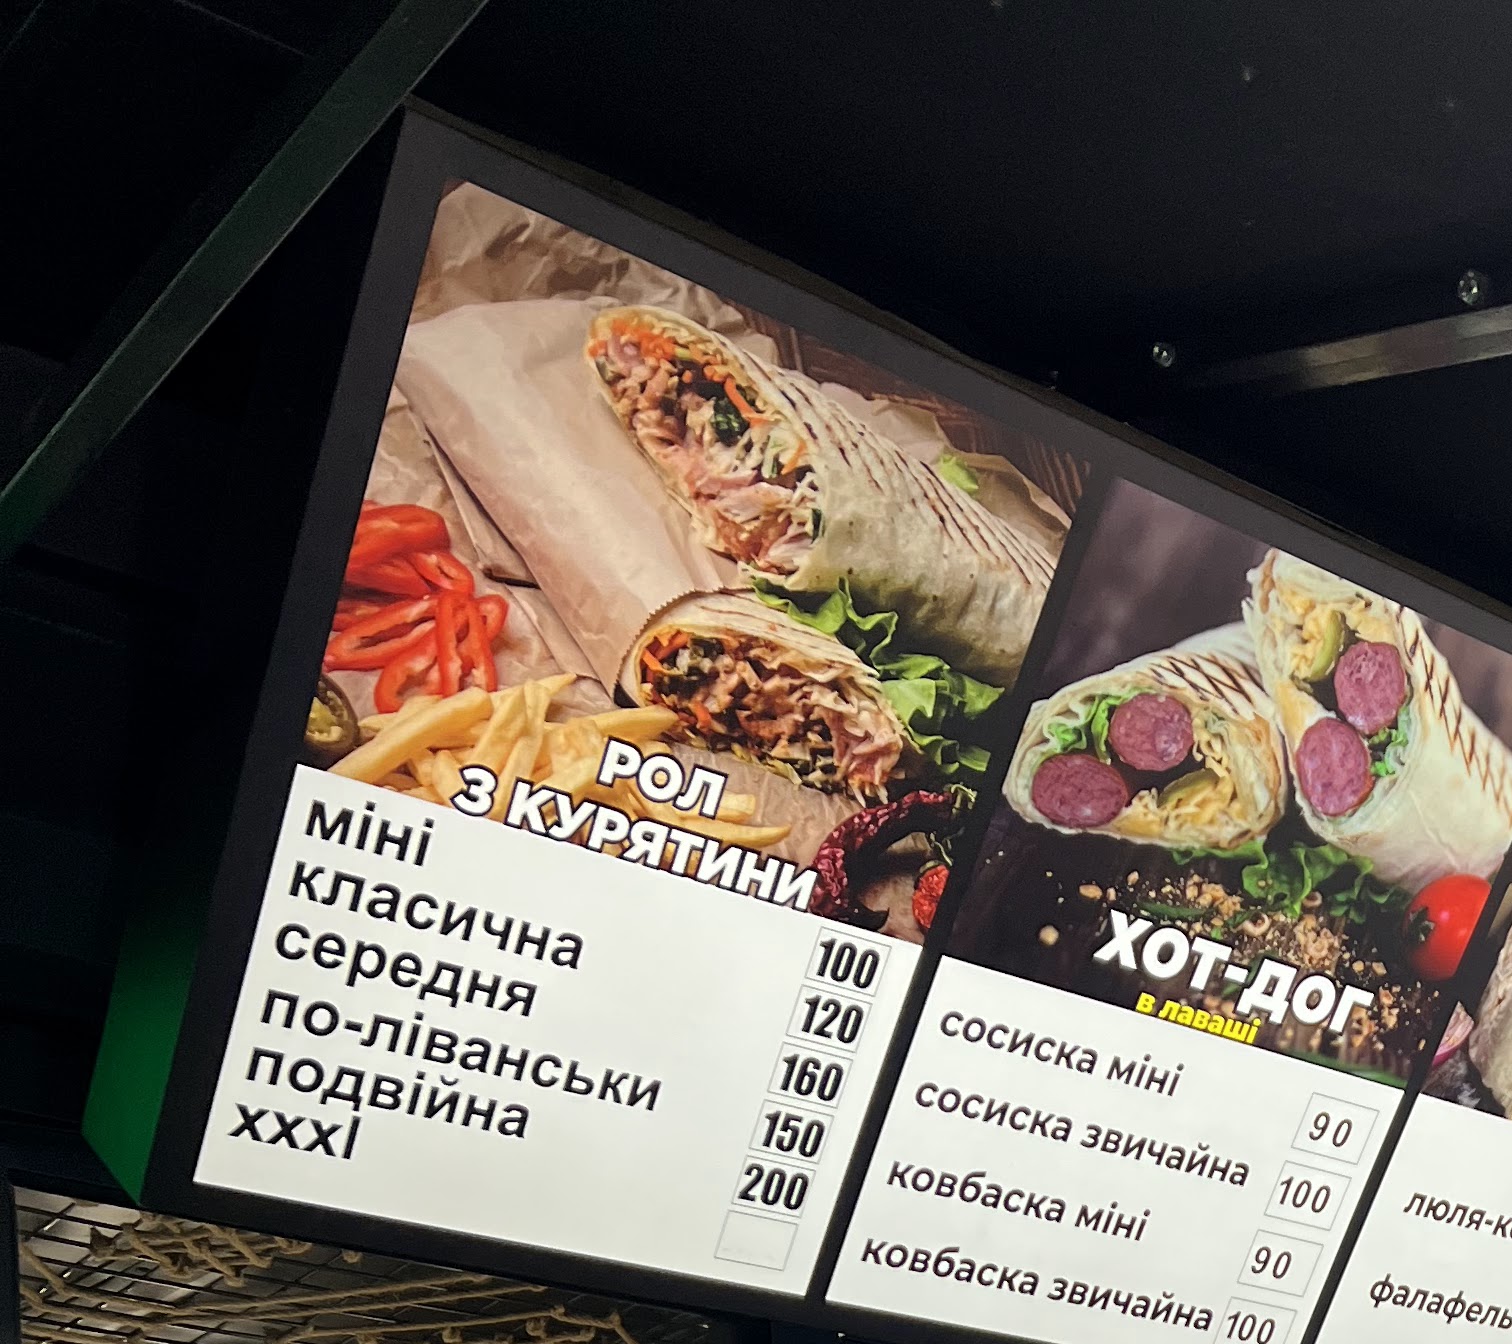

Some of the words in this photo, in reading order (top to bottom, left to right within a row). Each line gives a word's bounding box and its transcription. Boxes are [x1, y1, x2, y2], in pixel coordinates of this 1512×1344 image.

[597, 736, 729, 819] РОЛ
[304, 800, 436, 868] міні
[505, 780, 819, 913] КУРЯТИНИ
[287, 860, 585, 970] класична
[274, 924, 538, 1019] середня
[813, 937, 880, 989] 100
[1094, 908, 1374, 1033] ХОТ-ДОГ
[260, 989, 663, 1113] по-ліванськи
[796, 994, 863, 1045] 120
[939, 1010, 1098, 1074] сосиска
[1105, 1053, 1186, 1097] міні
[1135, 991, 1155, 1014] в
[1158, 997, 1260, 1046] лаваші
[245, 1045, 530, 1139] подвійна
[777, 1053, 843, 1102] 160
[760, 1109, 824, 1159] 150
[915, 1081, 1073, 1142] сосиска
[1080, 1122, 1250, 1187] звичайна
[1308, 1112, 1352, 1148] 90
[738, 1167, 808, 1213] 200
[887, 1160, 1066, 1224] ковбаска
[1074, 1203, 1151, 1243] міні
[1278, 1176, 1332, 1214] 100
[861, 1237, 1039, 1297] ковбаска
[1047, 1276, 1213, 1332] звичайна
[1251, 1246, 1292, 1279] 90
